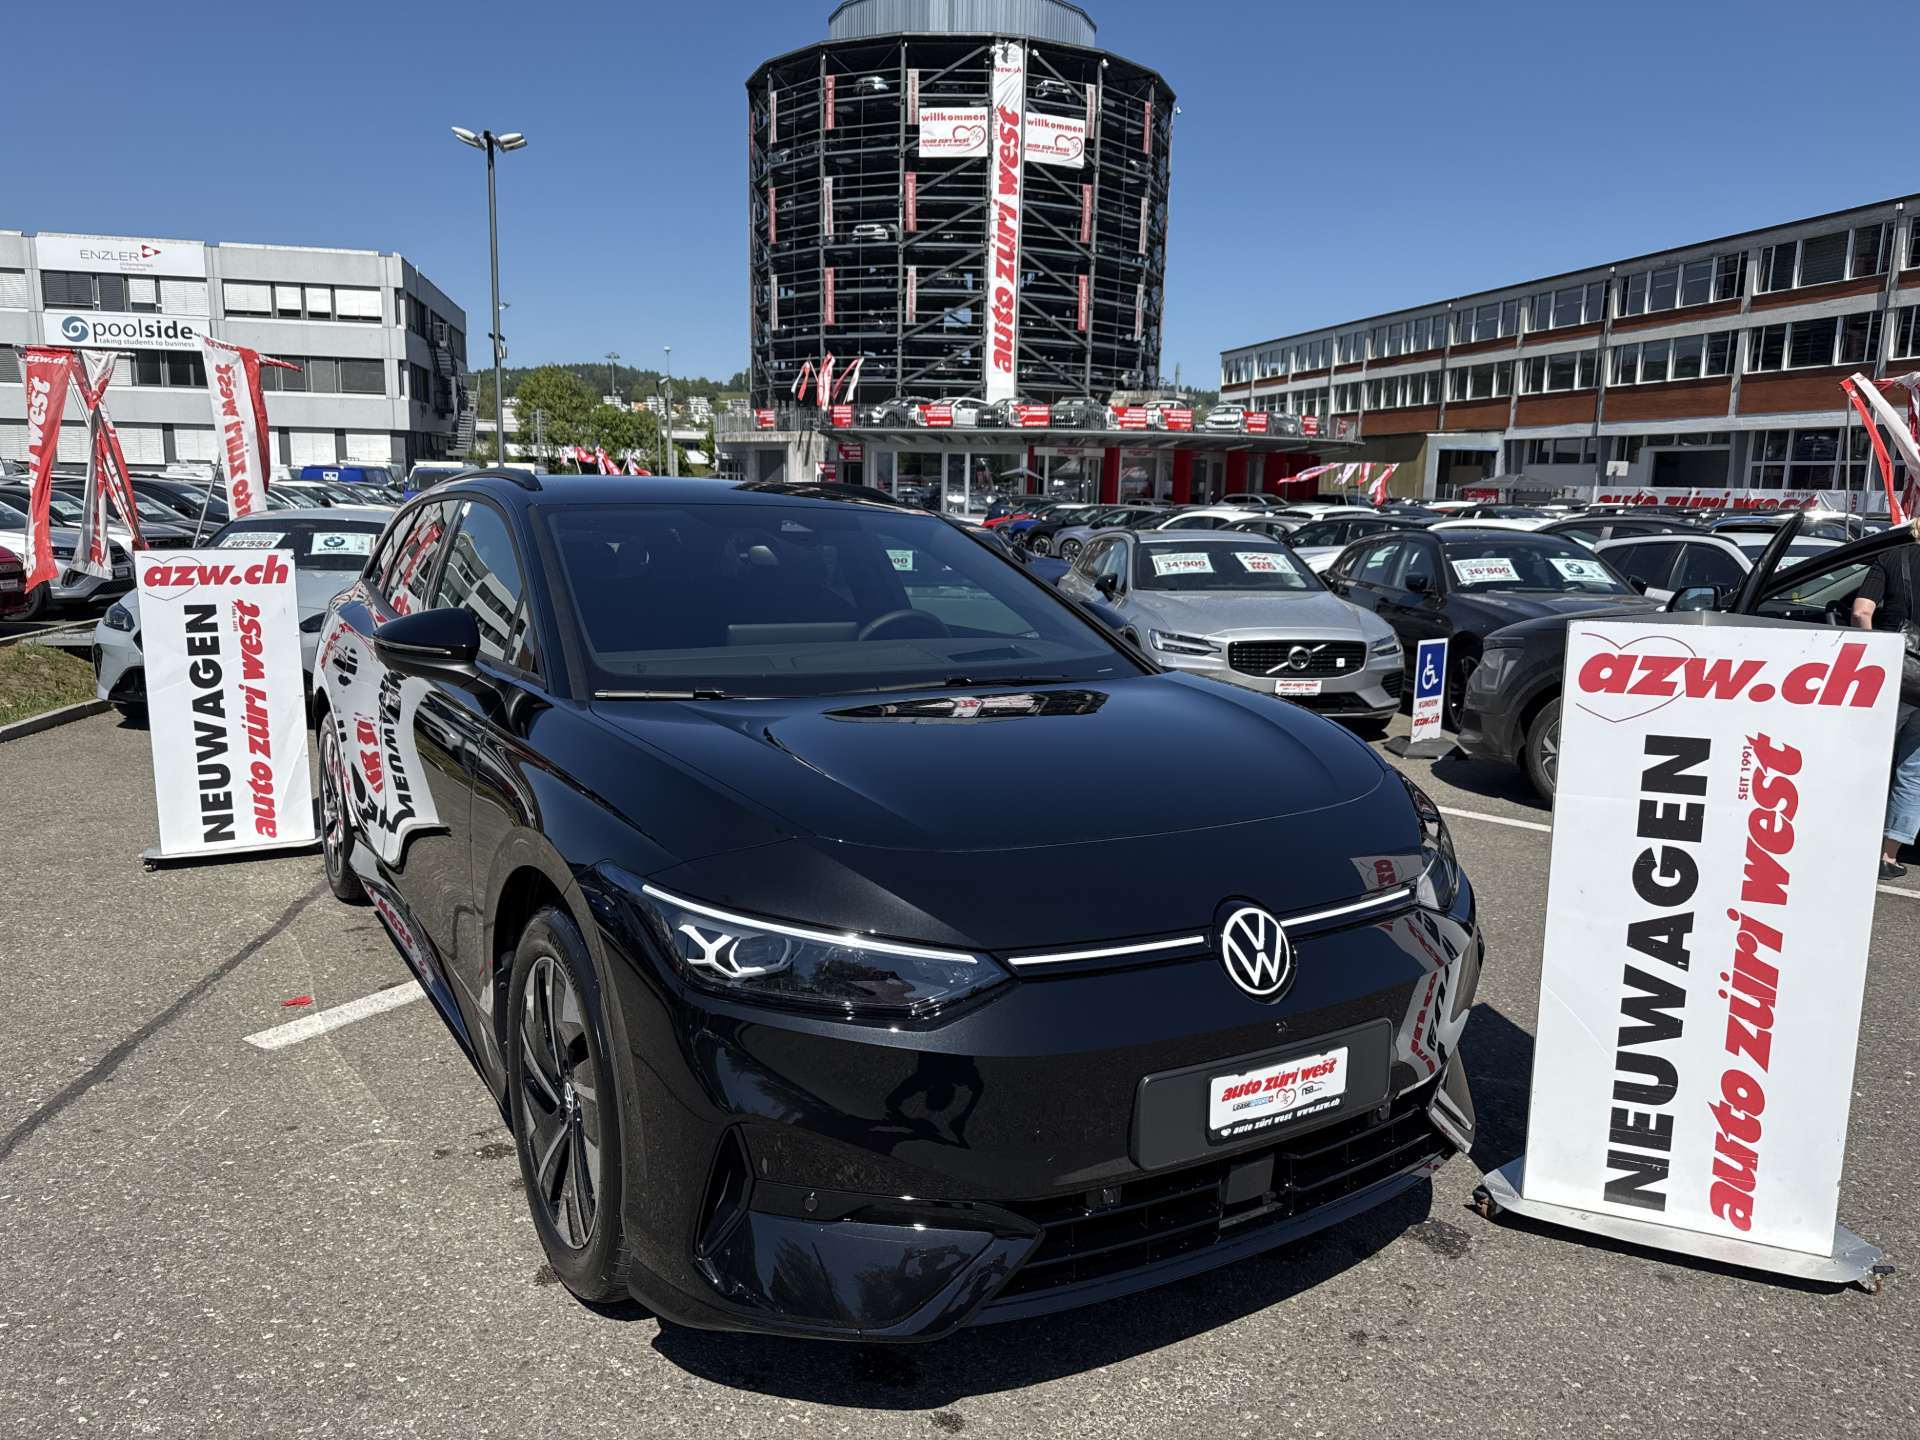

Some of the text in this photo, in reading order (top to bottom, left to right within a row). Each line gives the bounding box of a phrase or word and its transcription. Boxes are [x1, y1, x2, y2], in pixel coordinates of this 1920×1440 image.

[921, 112, 986, 121] willkommen
[1027, 117, 1084, 133] willkommen
[80, 249, 139, 262] ENZLER
[989, 105, 1020, 374] auto züri west
[92, 318, 194, 343] poolside
[99, 338, 122, 346] taking
[29, 377, 51, 446] west
[144, 555, 289, 587] azw.ch
[1466, 567, 1511, 577] 36'800
[1579, 643, 1886, 708] azw.ch
[184, 604, 236, 843] NEUWAGEN
[232, 599, 277, 838] auto züri west
[1414, 713, 1440, 726] azw.ch
[1738, 745, 1752, 800] SEIT 1991
[1603, 734, 1712, 1212] NEUWAGEN
[1708, 731, 1803, 1232] auto züri west
[1222, 1079, 1263, 1102] auto
[1263, 1067, 1301, 1092] züri
[1301, 1057, 1337, 1082] west
[1233, 1121, 1253, 1135] auto
[1254, 1116, 1273, 1129] züri
[1274, 1112, 1293, 1124] west
